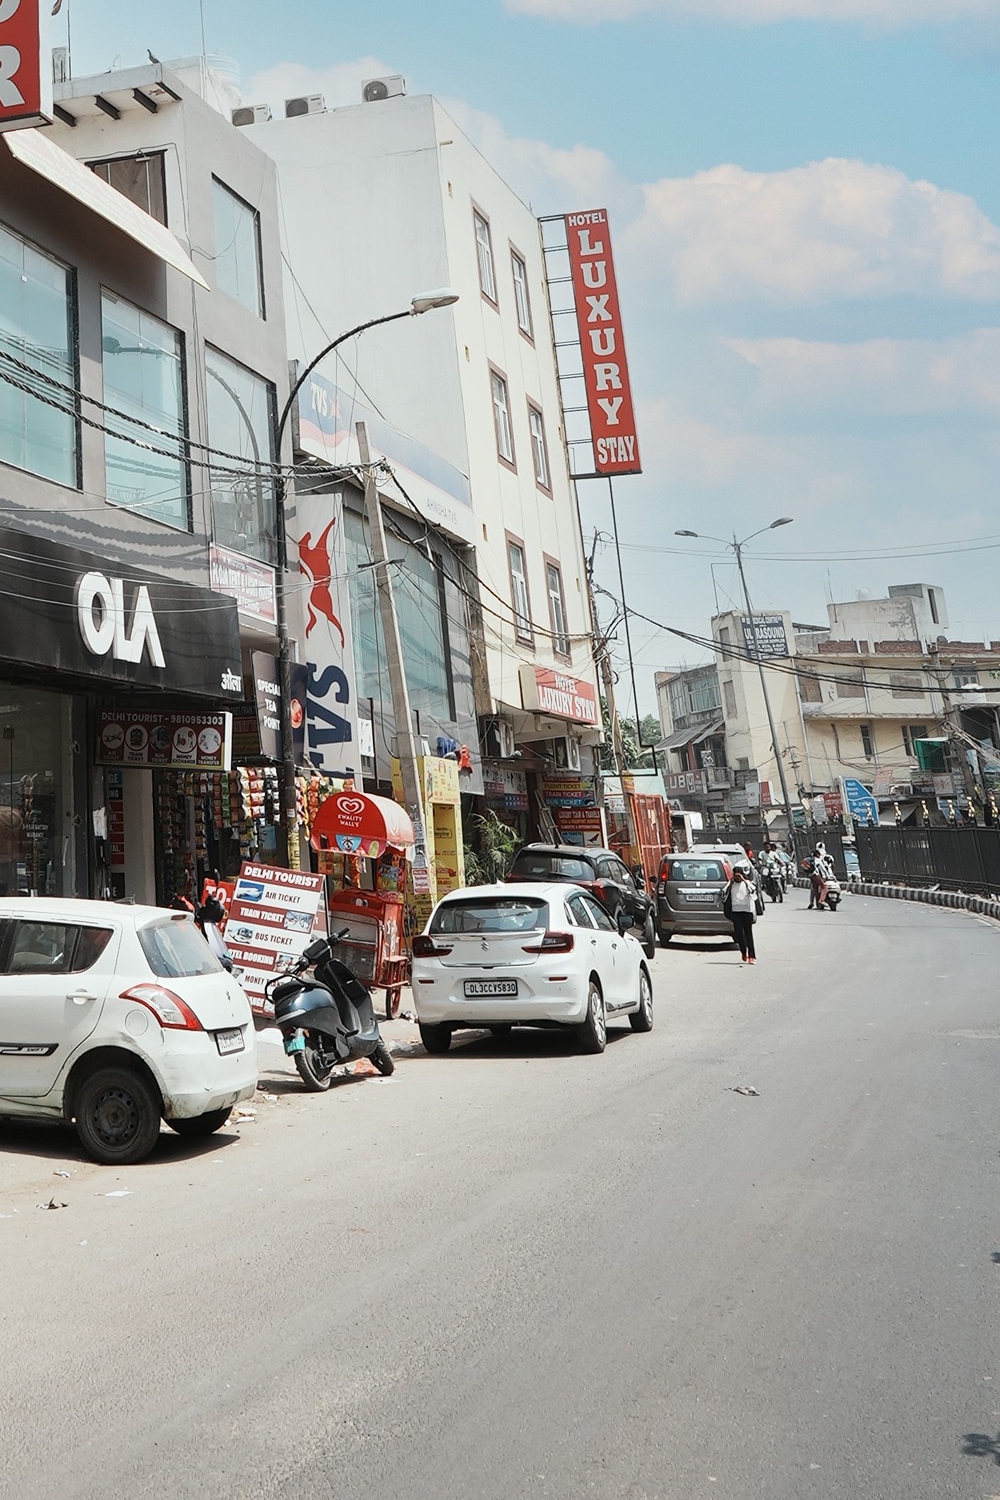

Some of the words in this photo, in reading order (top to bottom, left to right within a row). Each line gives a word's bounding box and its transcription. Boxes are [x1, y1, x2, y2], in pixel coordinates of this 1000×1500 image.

[568, 211, 606, 227] HOTEL
[577, 229, 624, 426] LUXURY
[310, 382, 328, 417] TVS
[597, 435, 635, 465] STAY
[73, 571, 167, 668] OLA
[744, 626, 785, 639] ULRASOUND
[220, 668, 242, 692] ओला
[554, 674, 578, 694] HOTEL
[264, 698, 277, 713] TEA
[538, 685, 574, 716] LUXURY
[574, 696, 596, 722] STAY
[101, 712, 125, 721] DELHI
[126, 713, 163, 723] TOURIST
[263, 715, 280, 731] POINT
[338, 813, 363, 822] KWALITY
[244, 865, 274, 880] DELHI
[275, 871, 319, 888] TOURIST
[265, 891, 277, 899] AIR
[278, 893, 300, 904] TICKET
[240, 907, 261, 918] TRAIN
[261, 910, 285, 922] TICKET
[255, 932, 269, 941] BUS
[270, 935, 293, 946] TICKET
[243, 951, 274, 965] BOOKING
[244, 975, 265, 985] MONEY
